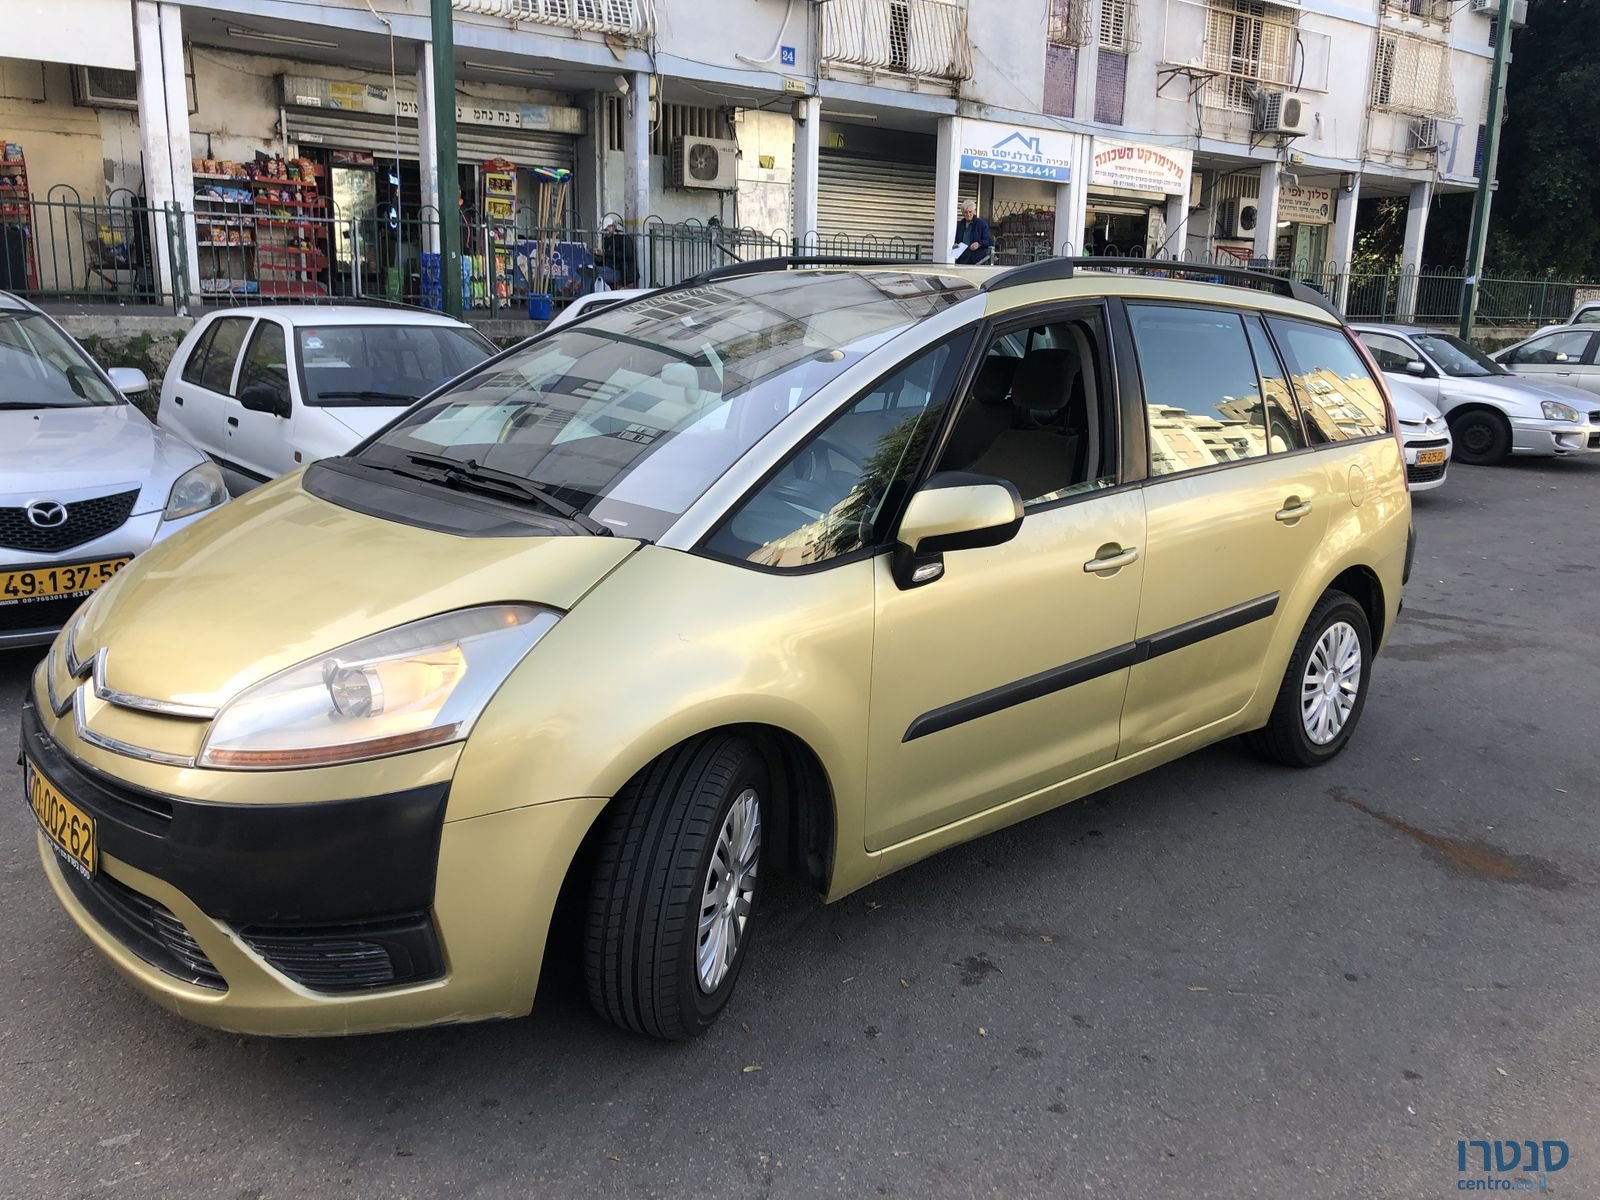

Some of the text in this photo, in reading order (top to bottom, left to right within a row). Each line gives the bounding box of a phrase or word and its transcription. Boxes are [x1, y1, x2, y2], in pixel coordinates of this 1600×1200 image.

[782, 50, 794, 62] 24
[473, 108, 494, 121] נחמ
[498, 111, 510, 122] נח
[963, 148, 1069, 166] מכירה הנדלניסט השכרה
[1094, 147, 1134, 167] השכונה
[1137, 147, 1184, 180] מינימרקט
[972, 159, 1057, 177] 054-2234411
[1307, 188, 1328, 201] סלון
